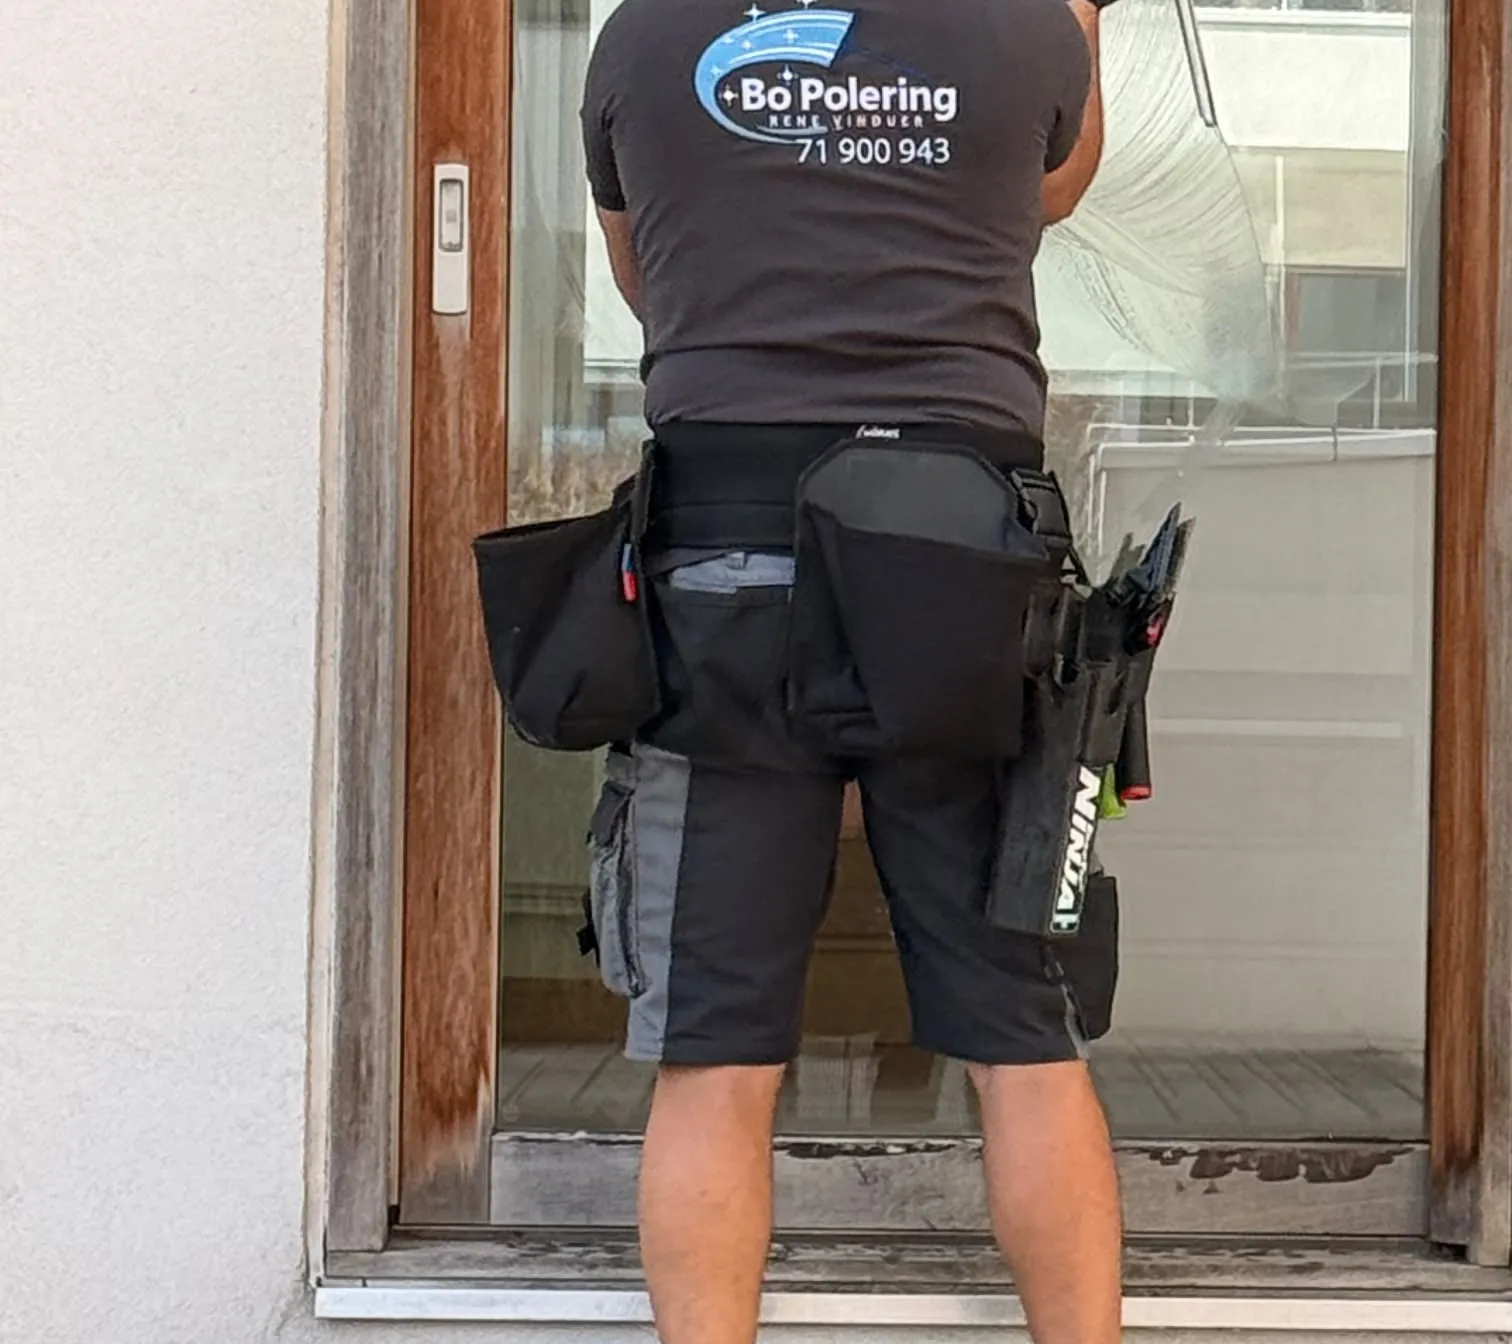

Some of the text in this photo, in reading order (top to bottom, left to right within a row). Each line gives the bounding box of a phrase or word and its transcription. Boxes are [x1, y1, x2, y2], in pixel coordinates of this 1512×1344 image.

[740, 76, 957, 122] Bo Polering
[832, 113, 924, 130] VINDUER
[798, 138, 950, 164] 71 900 943
